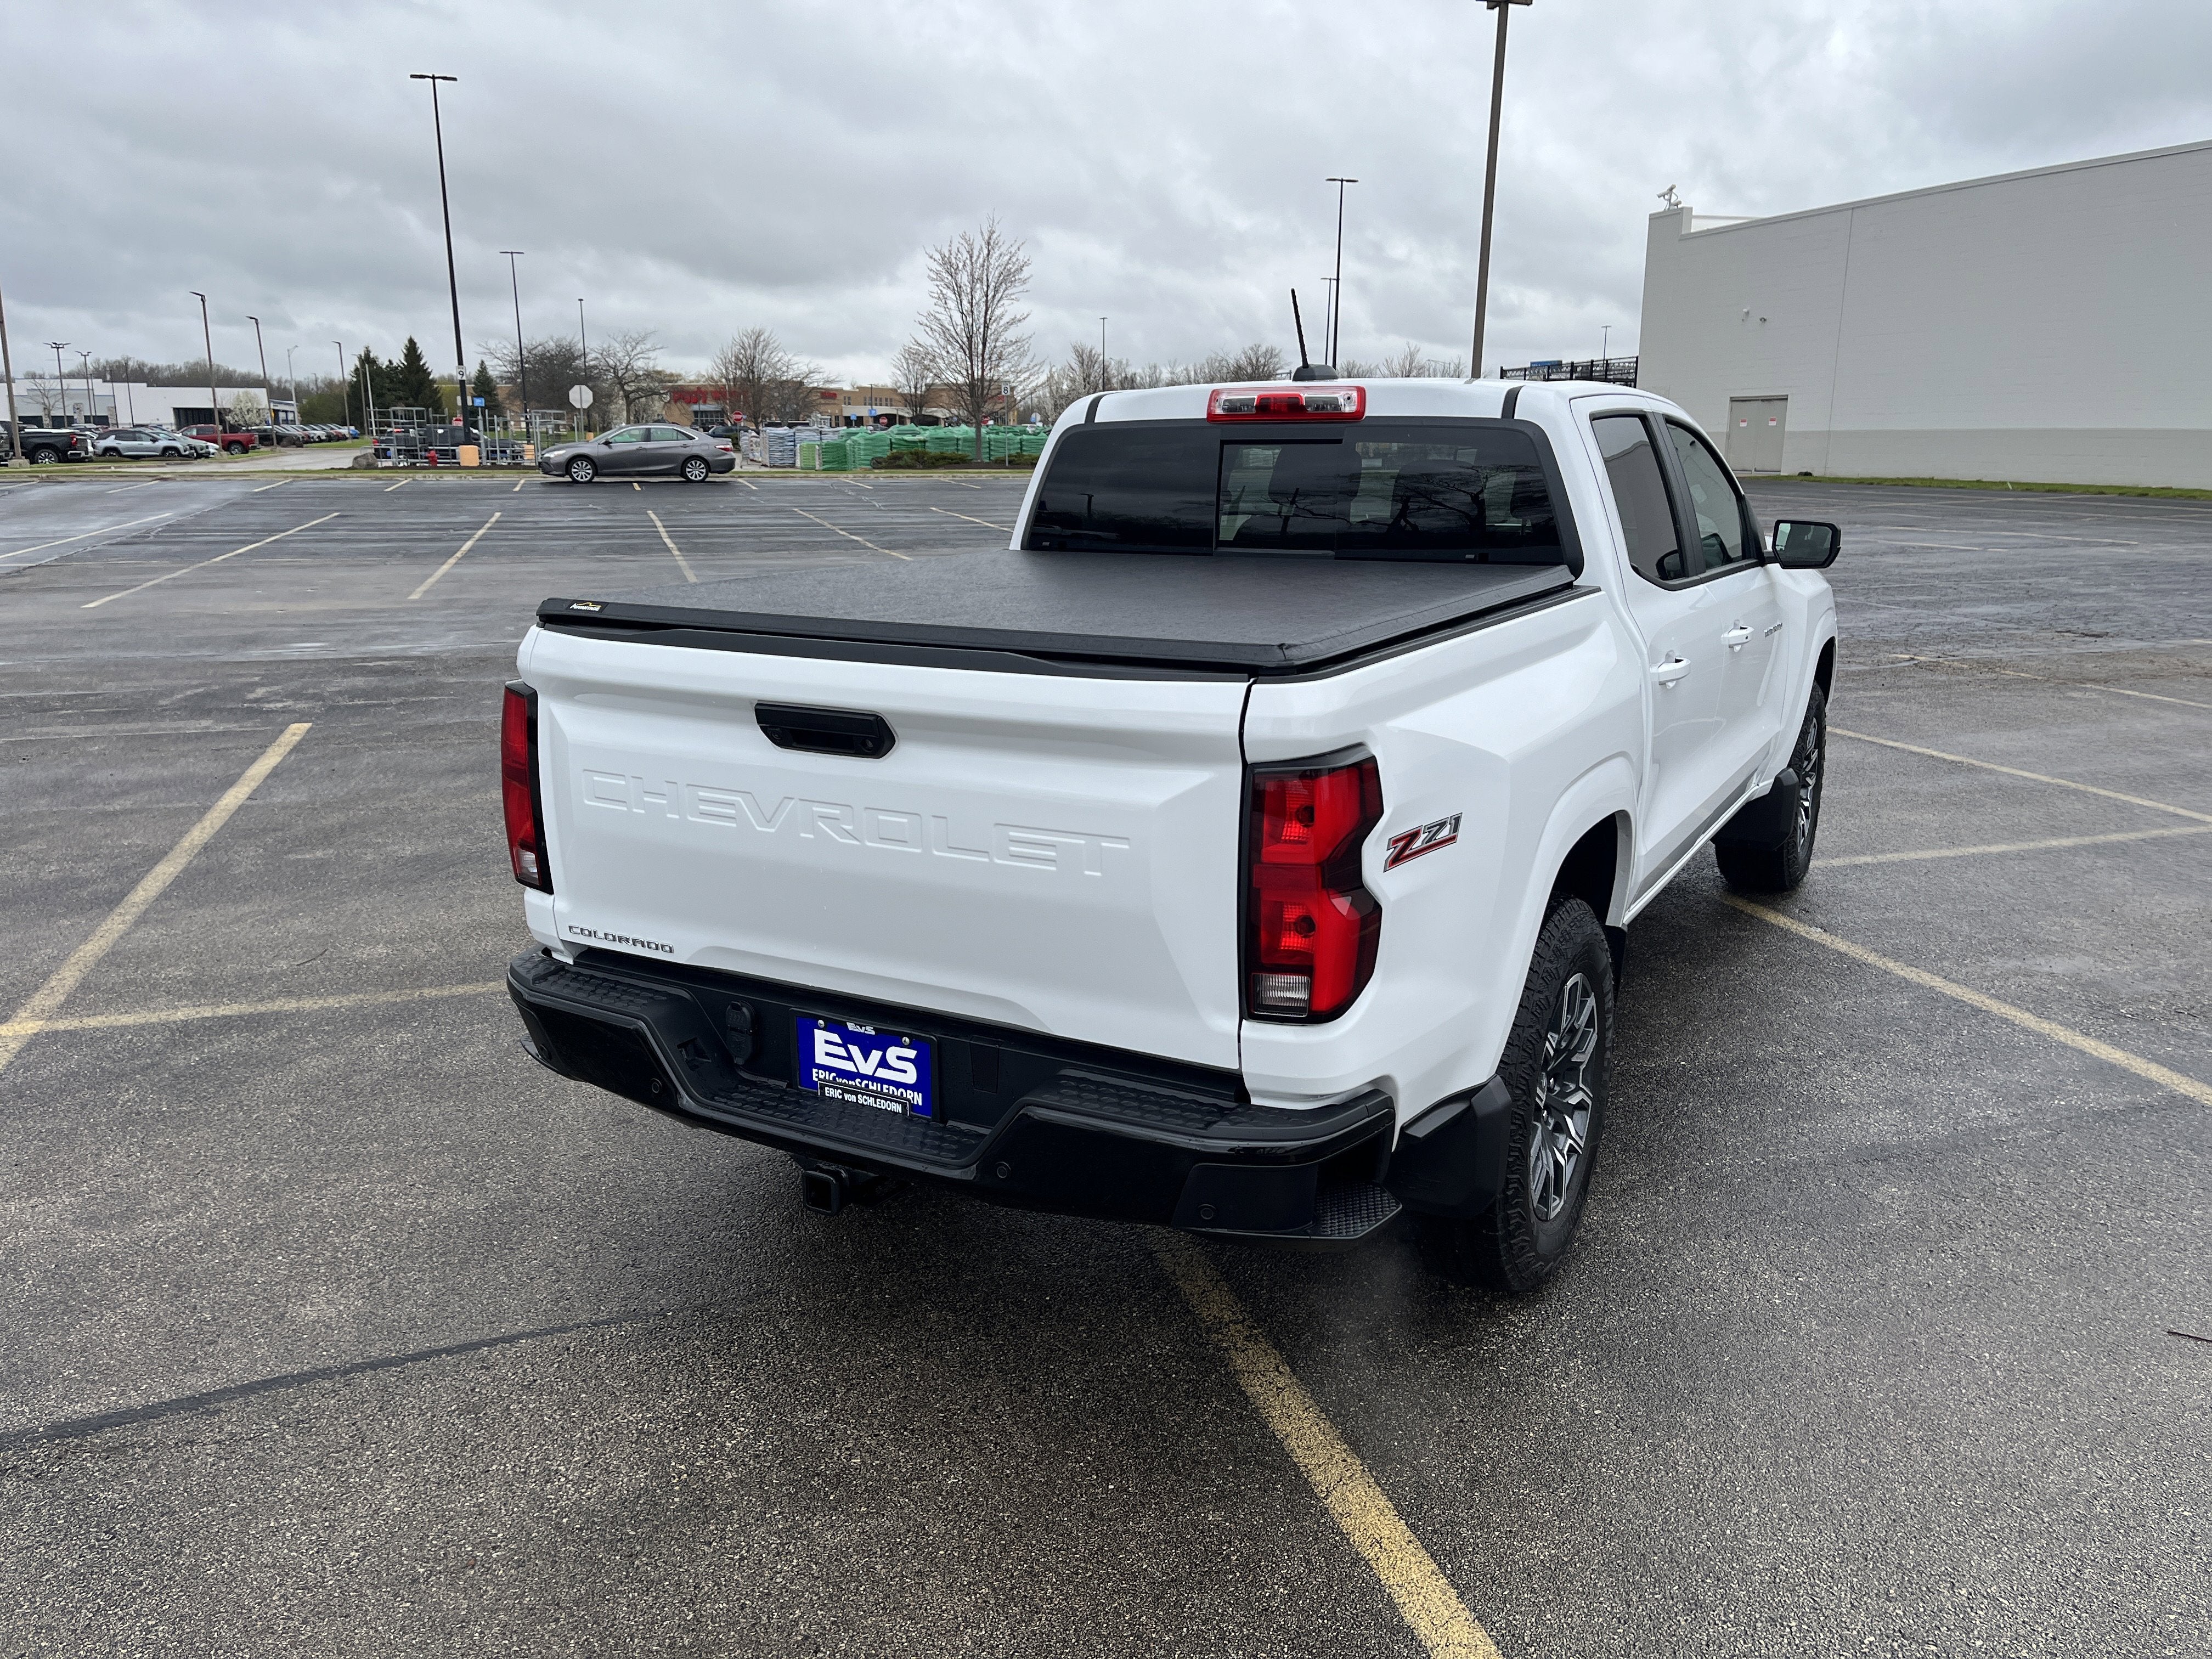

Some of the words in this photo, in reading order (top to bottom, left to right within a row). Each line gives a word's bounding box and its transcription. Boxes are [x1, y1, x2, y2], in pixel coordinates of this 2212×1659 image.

[458, 370, 464, 379] 9
[1003, 386, 1008, 394] 8
[583, 769, 1131, 877] CHEVROLET
[1383, 812, 1463, 873] Z71
[568, 924, 675, 953] COLORADO
[825, 1087, 842, 1099] ERIC
[844, 1093, 856, 1103] von
[857, 1094, 902, 1114] SCHLEDORN
